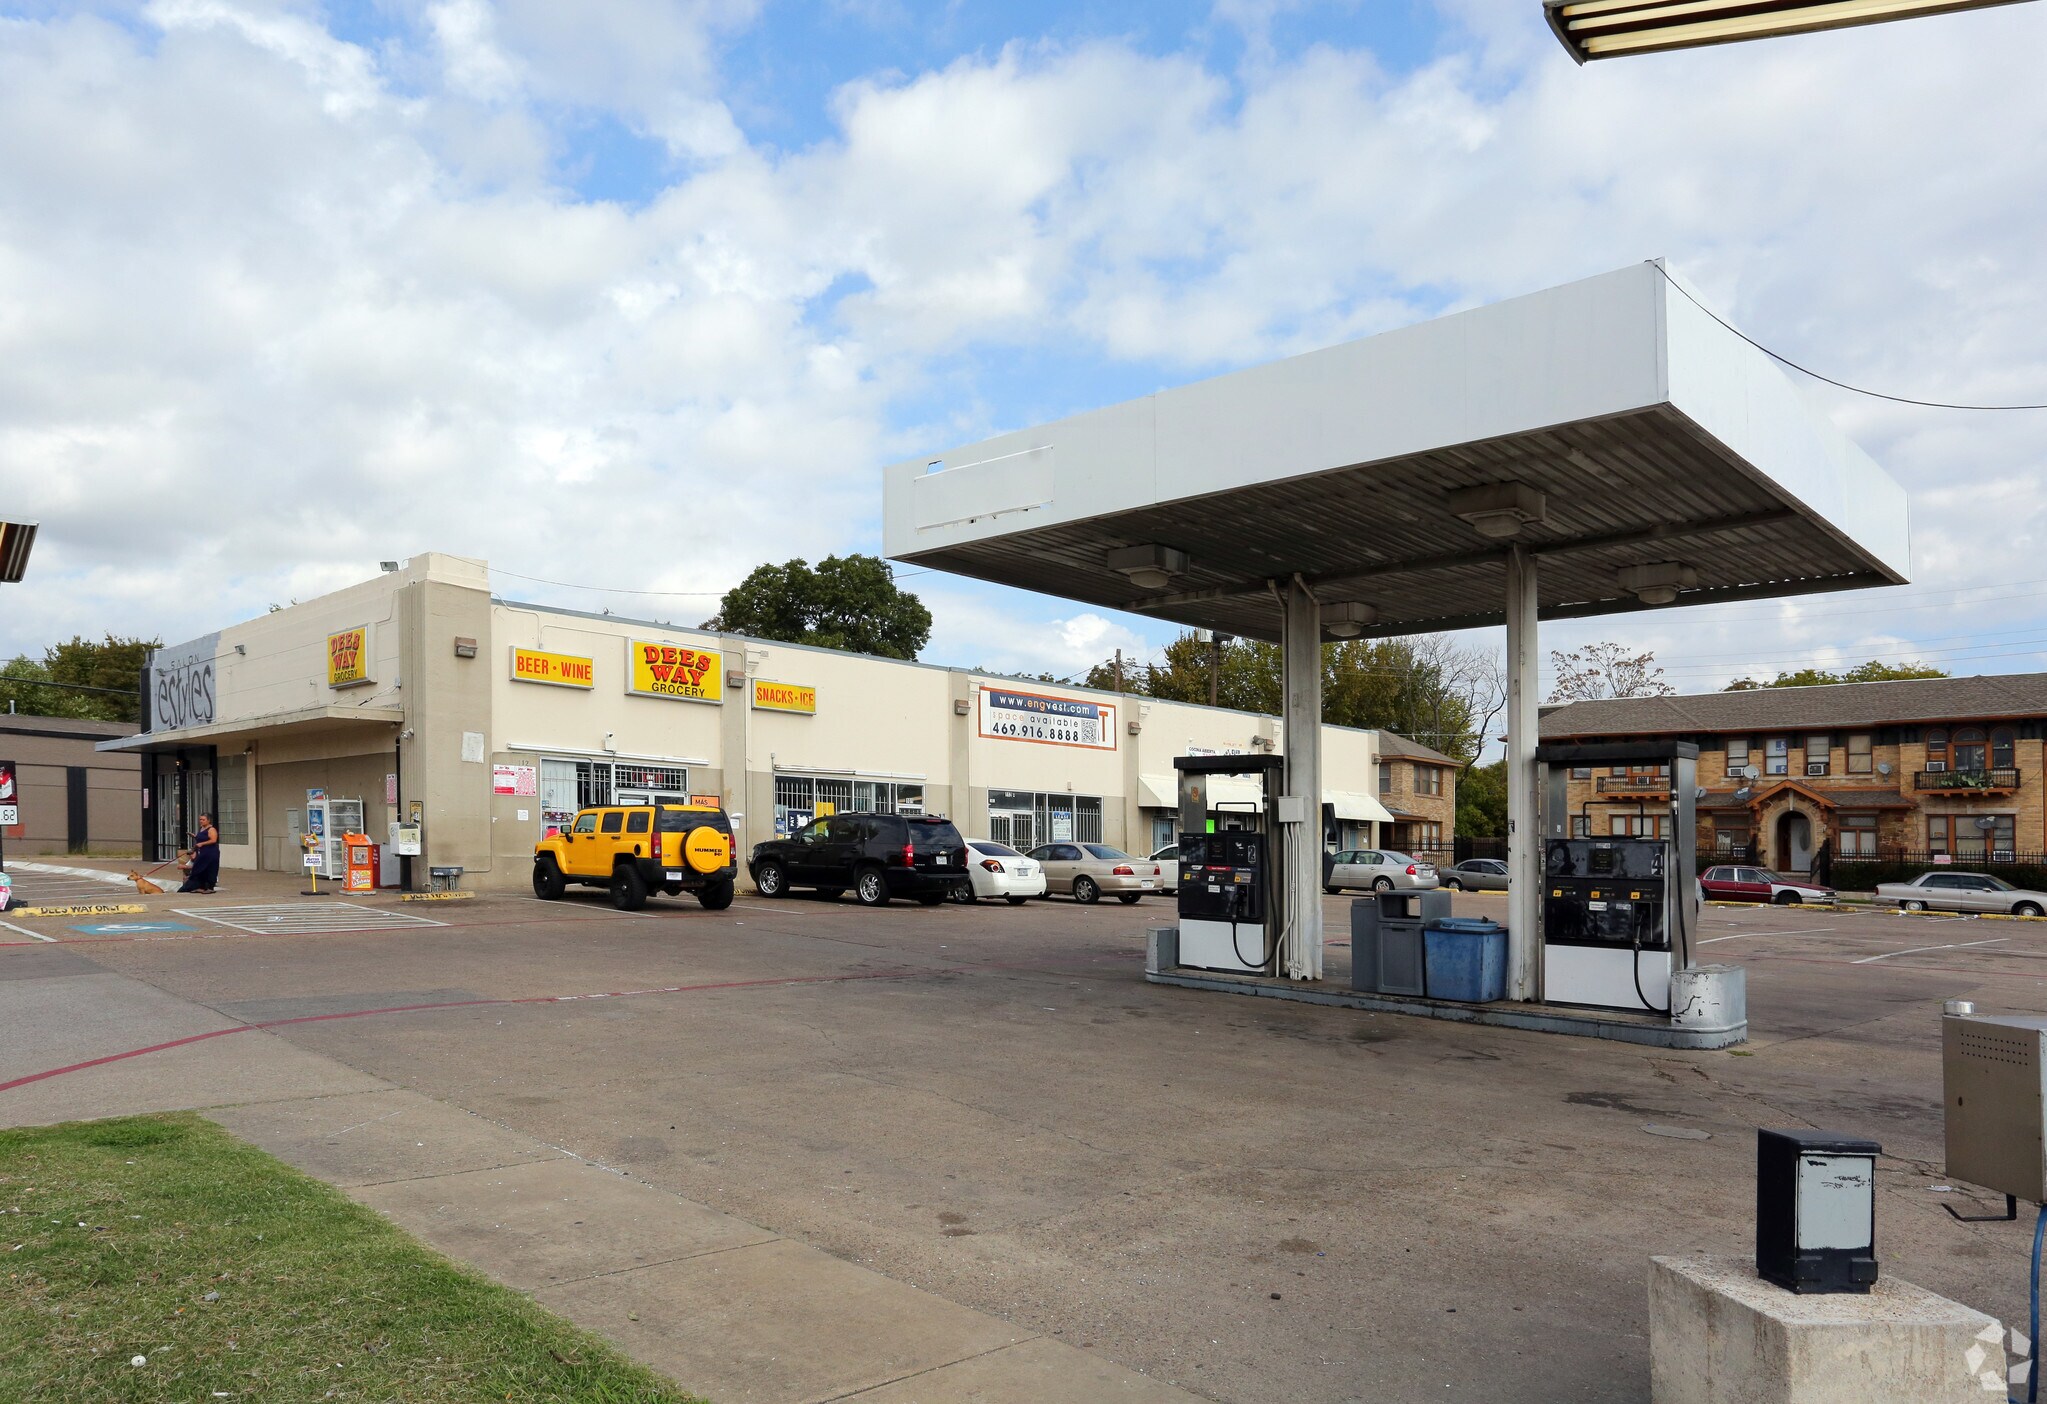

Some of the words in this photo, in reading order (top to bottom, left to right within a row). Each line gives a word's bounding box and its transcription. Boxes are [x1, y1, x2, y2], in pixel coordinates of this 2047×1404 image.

[331, 632, 360, 656] DEES
[170, 653, 200, 670] SALON
[333, 650, 357, 671] WAY
[517, 655, 549, 675] BEER
[561, 661, 591, 680] WINE
[644, 646, 711, 671] DEES
[334, 668, 358, 682] GROCERY
[650, 665, 705, 686] WAY
[651, 682, 705, 697] GROCERY
[756, 687, 794, 704] SNACKS
[800, 692, 814, 707] ICE
[999, 695, 1090, 715] www.engvest.com
[992, 711, 1025, 722] space
[1029, 715, 1079, 728] available
[992, 722, 1079, 742] 469.916.8888
[694, 798, 708, 806] MÁS
[1248, 845, 1257, 863] 2
[1651, 853, 1664, 875] 4
[70, 905, 93, 913] WAY
